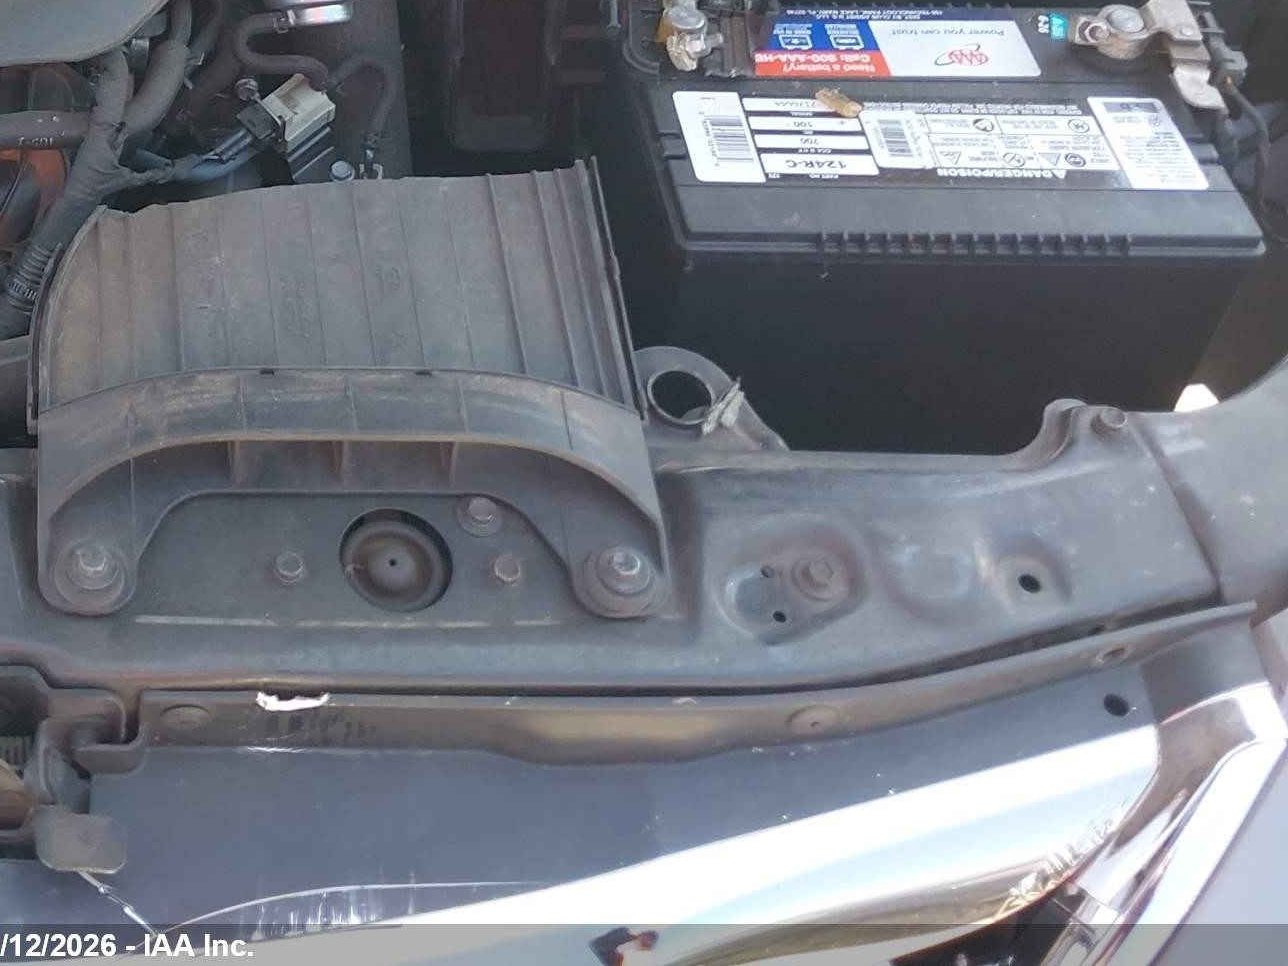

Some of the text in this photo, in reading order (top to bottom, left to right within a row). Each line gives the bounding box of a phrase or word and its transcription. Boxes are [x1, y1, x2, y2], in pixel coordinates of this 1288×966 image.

[943, 27, 966, 36] you
[968, 29, 1005, 37] Power
[839, 54, 871, 63] Call:
[949, 53, 987, 66] AAA
[783, 61, 876, 73] Need a battery?
[799, 137, 819, 145] 700
[785, 159, 847, 169] 124R-C
